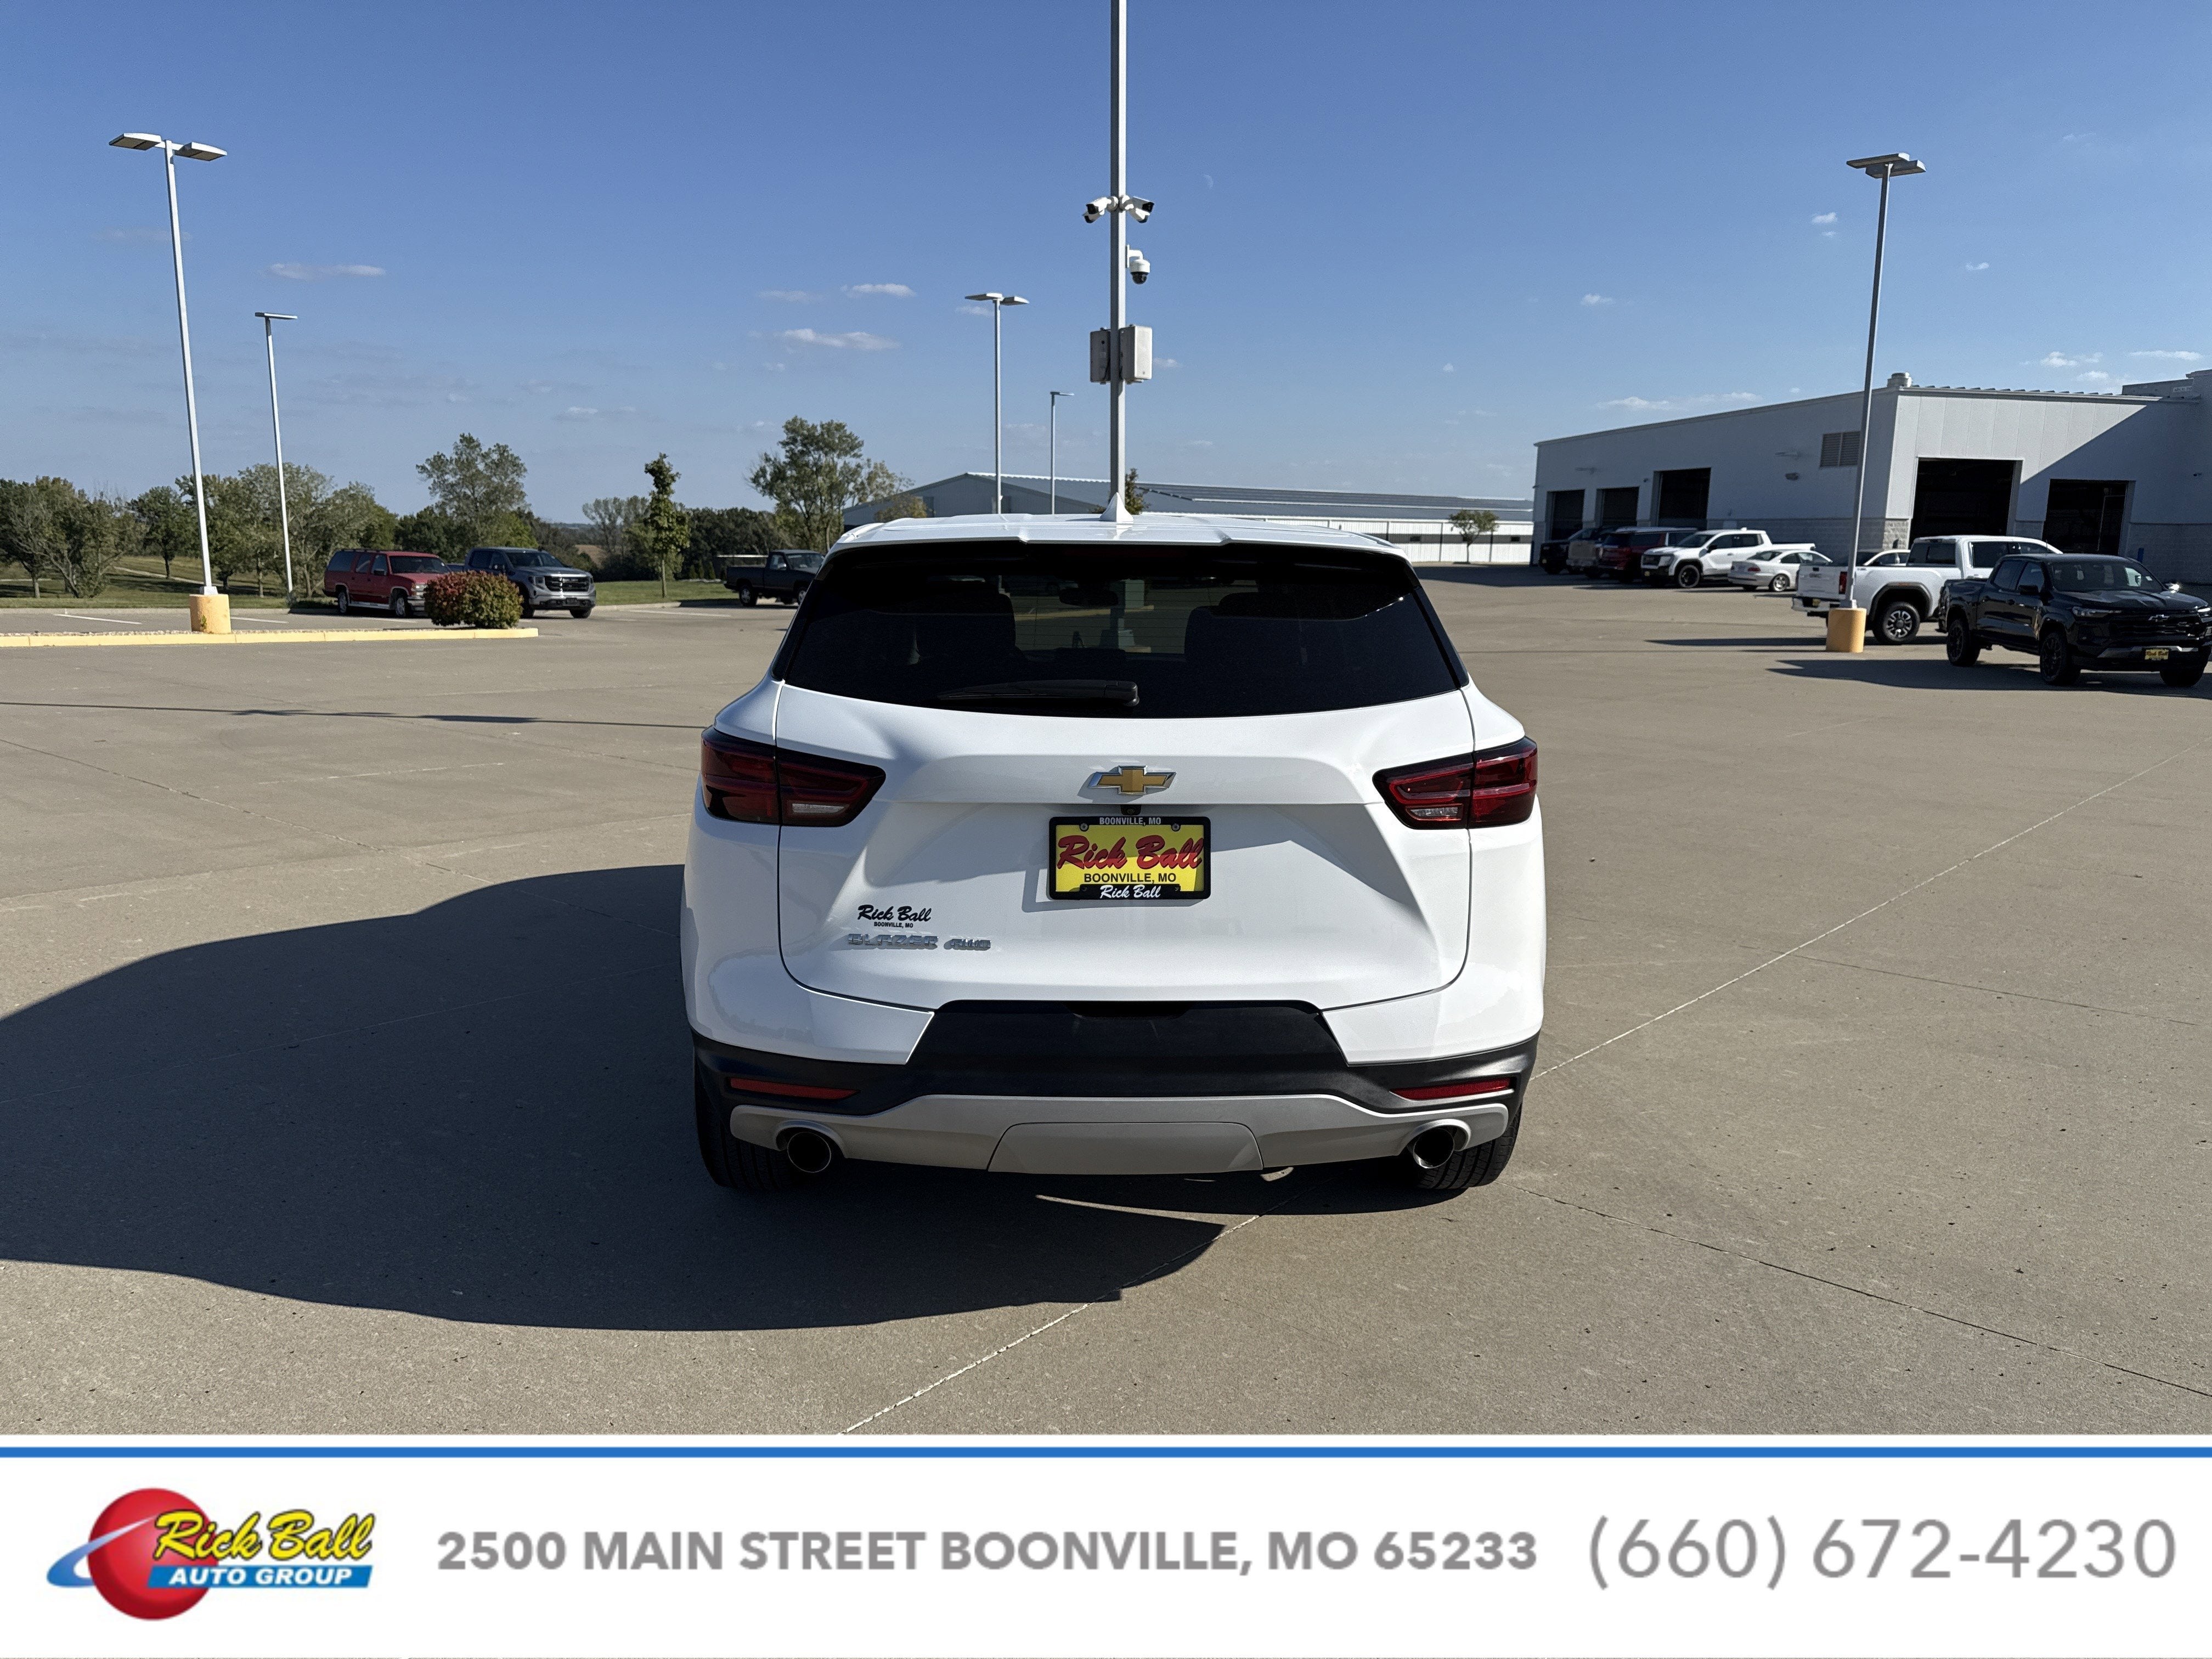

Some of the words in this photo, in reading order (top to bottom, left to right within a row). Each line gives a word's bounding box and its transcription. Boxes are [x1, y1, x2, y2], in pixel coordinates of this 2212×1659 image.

[1099, 817, 1146, 826] BOONVILLE,
[1148, 817, 1161, 825] MO
[1057, 835, 1127, 870] Rick
[1135, 834, 1204, 870] Ball
[1084, 873, 1155, 884] BOONVILLE,
[1158, 873, 1177, 882] MO
[1099, 884, 1130, 899] Rick
[1133, 884, 1161, 899] Ball
[857, 904, 894, 921] Rick
[897, 905, 932, 922] Ball
[848, 933, 939, 947] BLAZER
